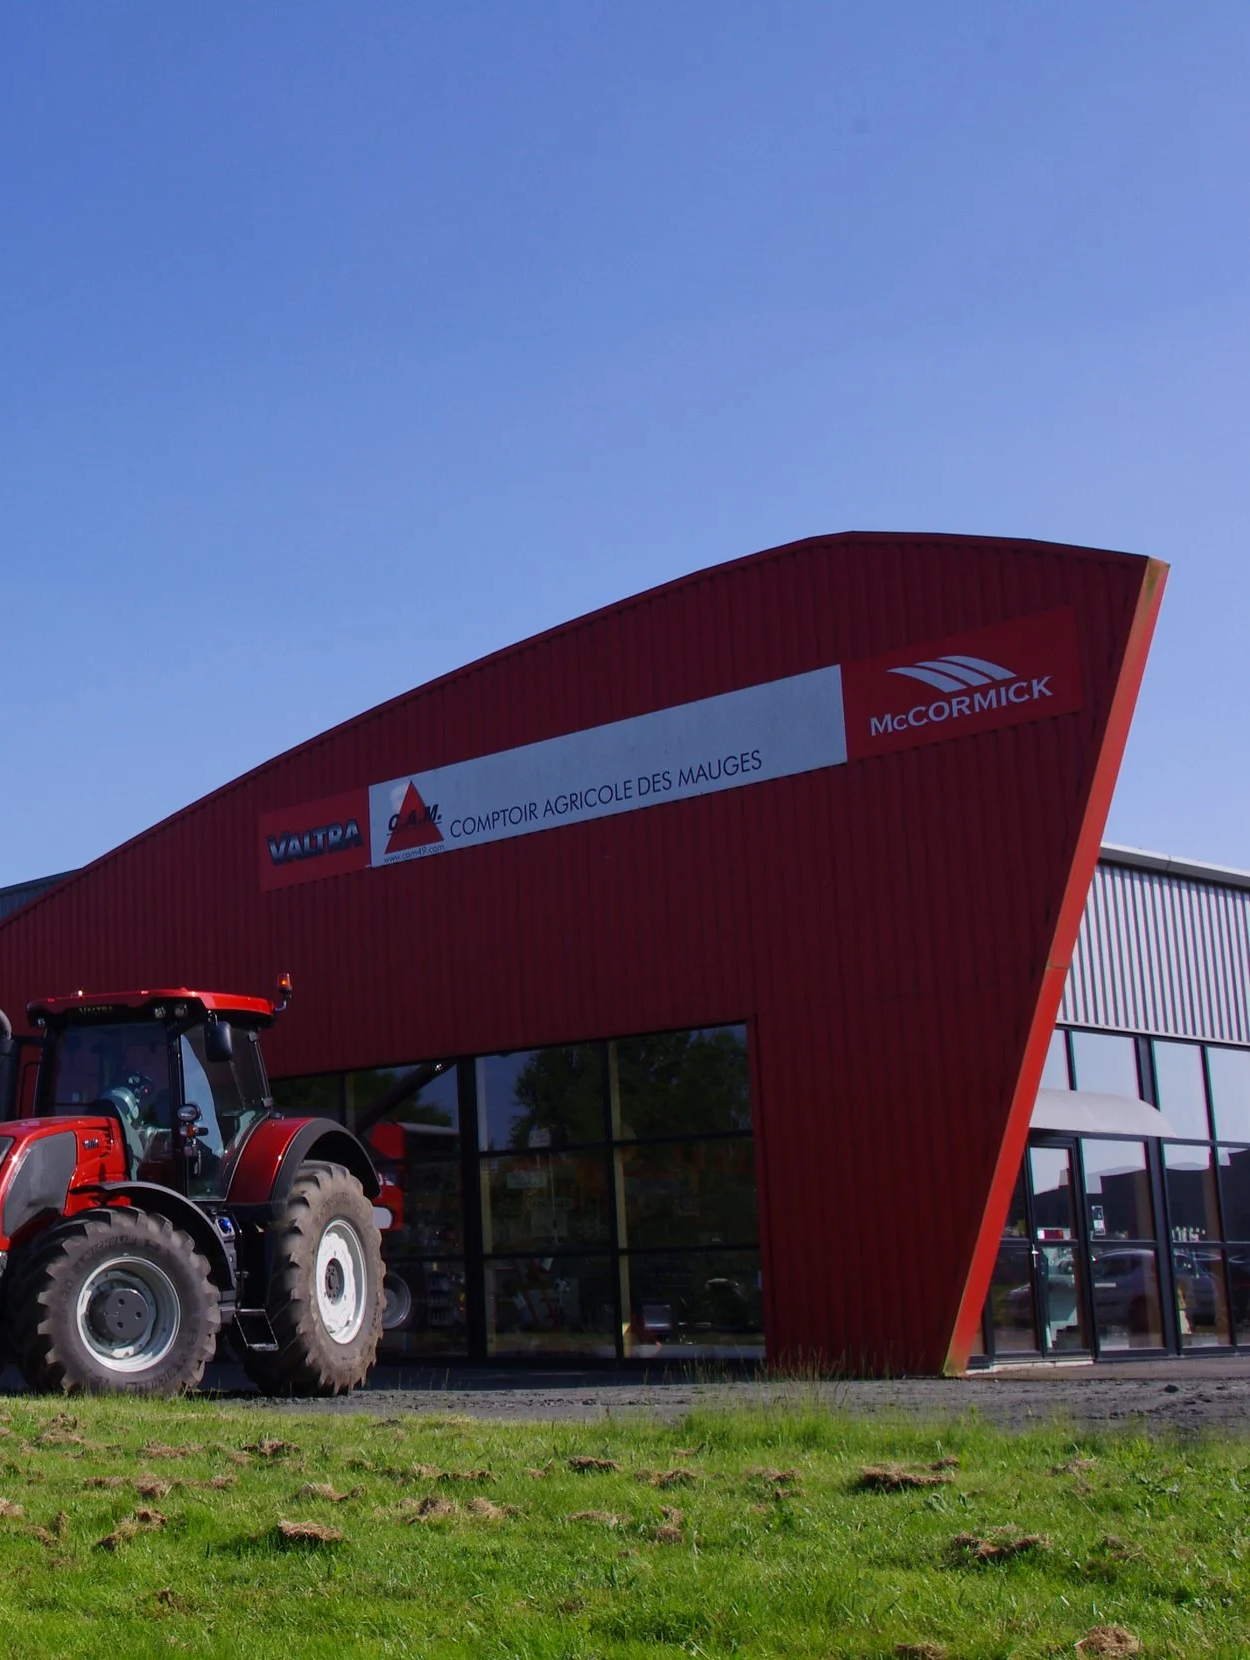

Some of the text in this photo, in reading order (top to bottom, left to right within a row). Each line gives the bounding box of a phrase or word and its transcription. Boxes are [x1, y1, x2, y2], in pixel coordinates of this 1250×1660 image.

[870, 676, 1054, 736] McCORMICK
[449, 749, 763, 838] COMPTOIR AGRICOLE DES MAUGES
[266, 820, 364, 865] VALTRA
